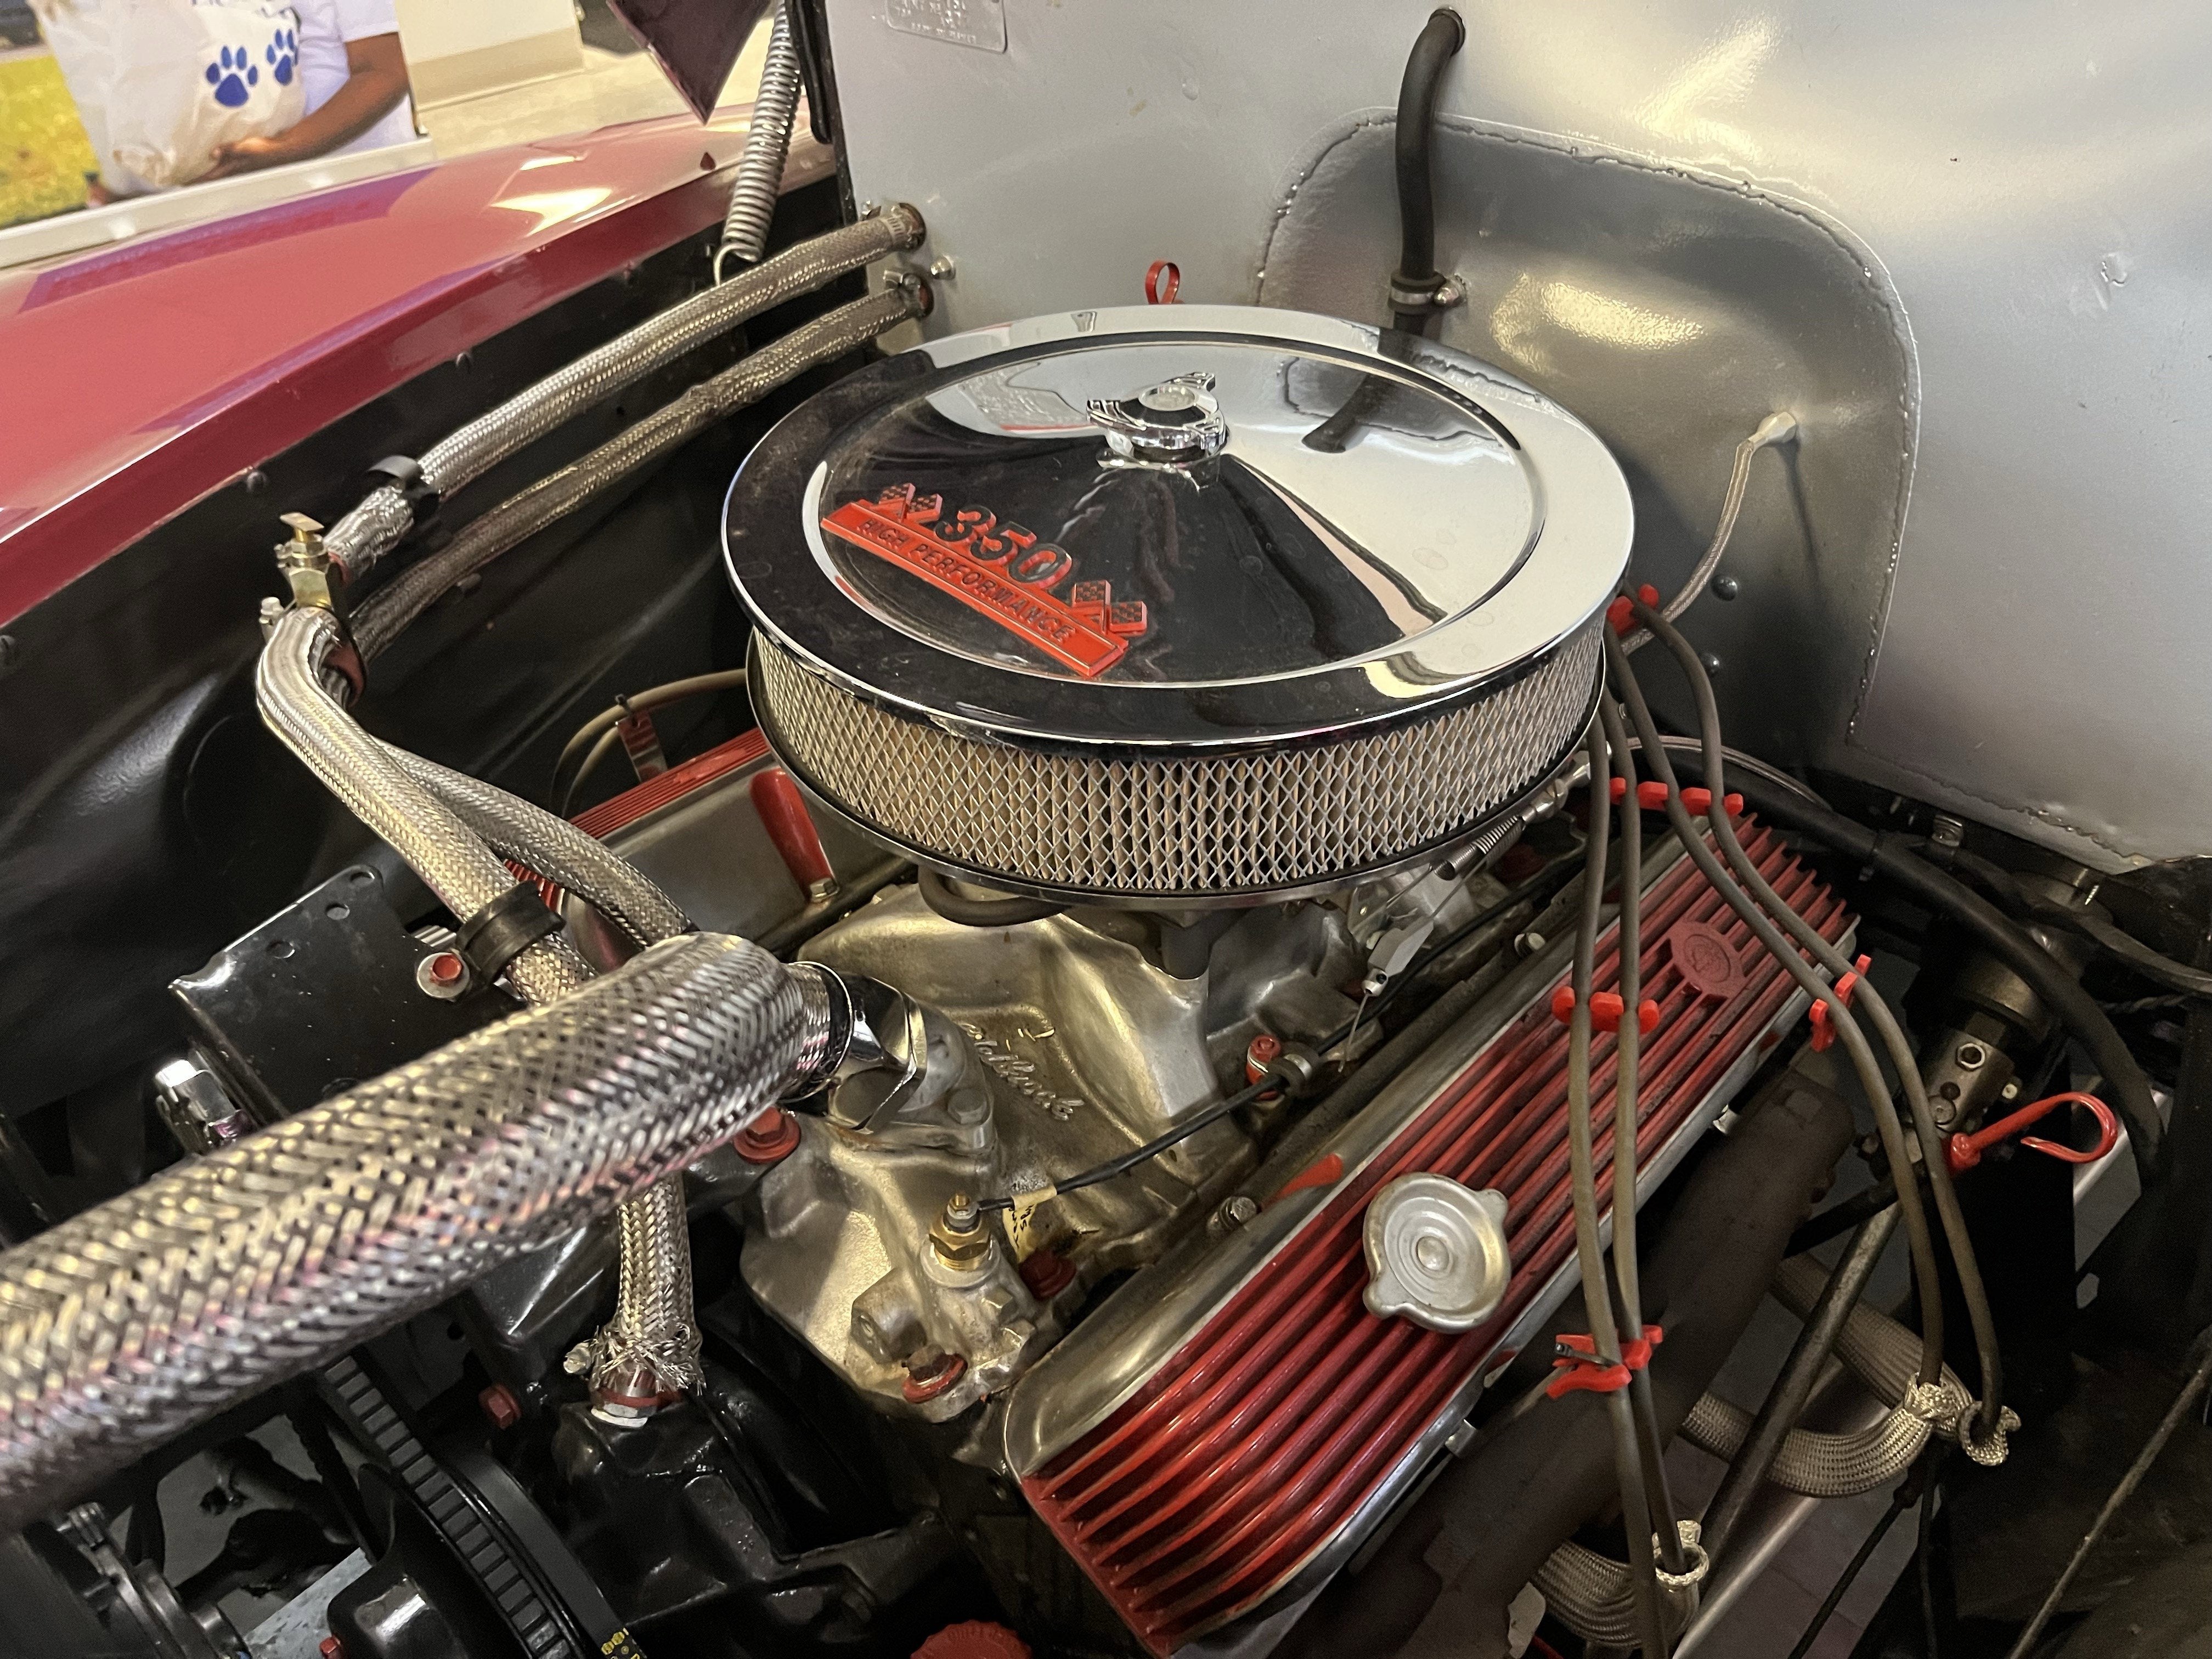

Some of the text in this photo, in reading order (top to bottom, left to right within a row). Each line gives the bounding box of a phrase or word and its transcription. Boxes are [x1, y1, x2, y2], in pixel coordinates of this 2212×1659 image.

[857, 518, 1076, 642] HIGH PERFORMANCE
[935, 505, 1071, 587] 350
